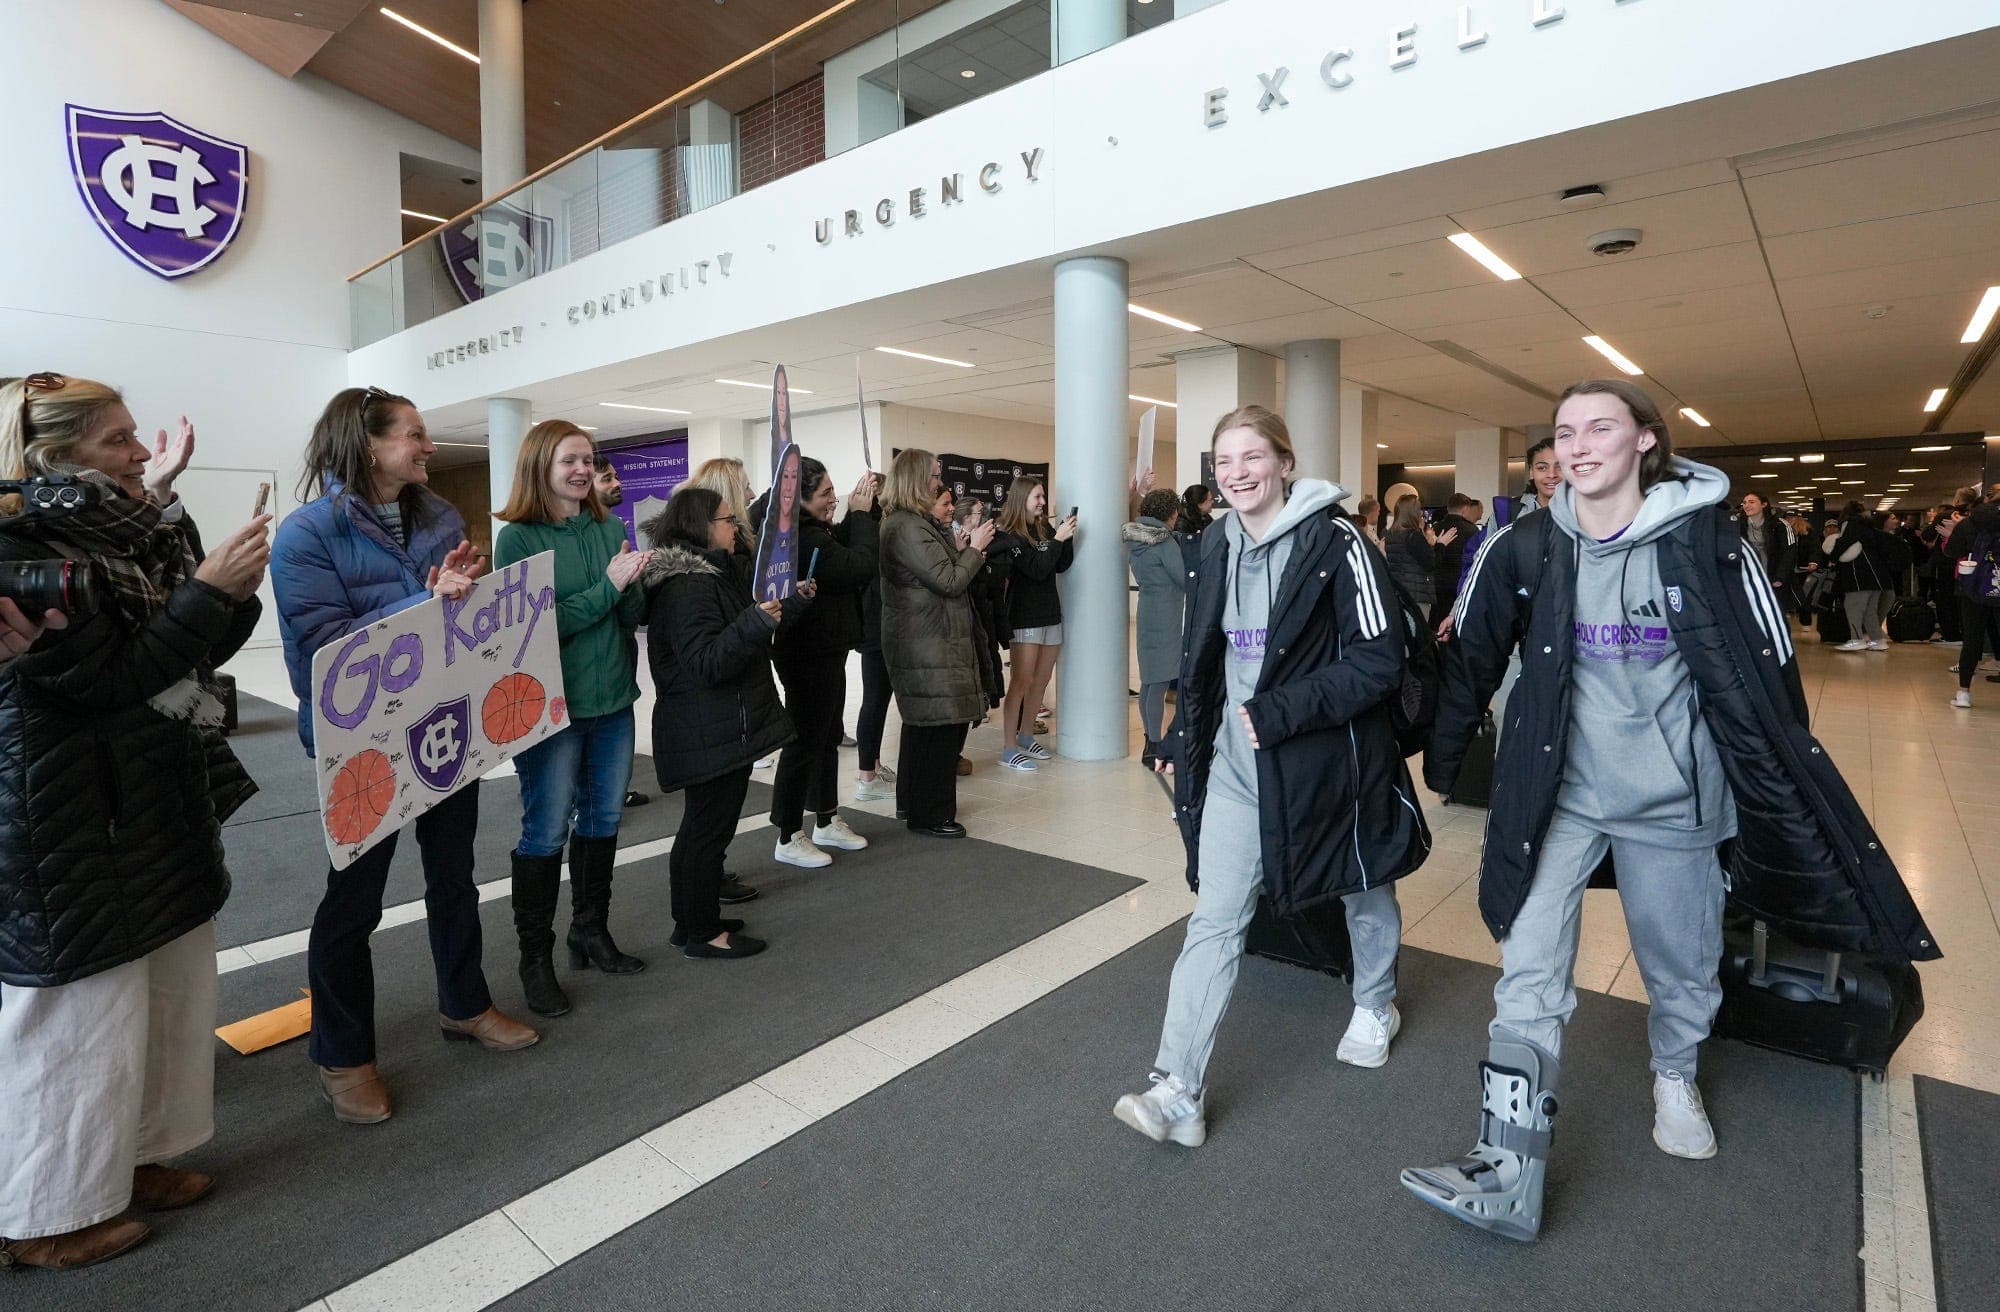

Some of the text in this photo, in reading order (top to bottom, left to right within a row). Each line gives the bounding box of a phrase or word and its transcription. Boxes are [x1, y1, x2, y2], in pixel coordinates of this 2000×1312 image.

[815, 147, 1045, 246] URGENCY
[567, 252, 733, 325] COMMUNITY
[427, 326, 523, 370] INTEGRITY
[623, 458, 686, 471] MISSION STATEMENT
[1574, 621, 1642, 646] HOLY CROSS
